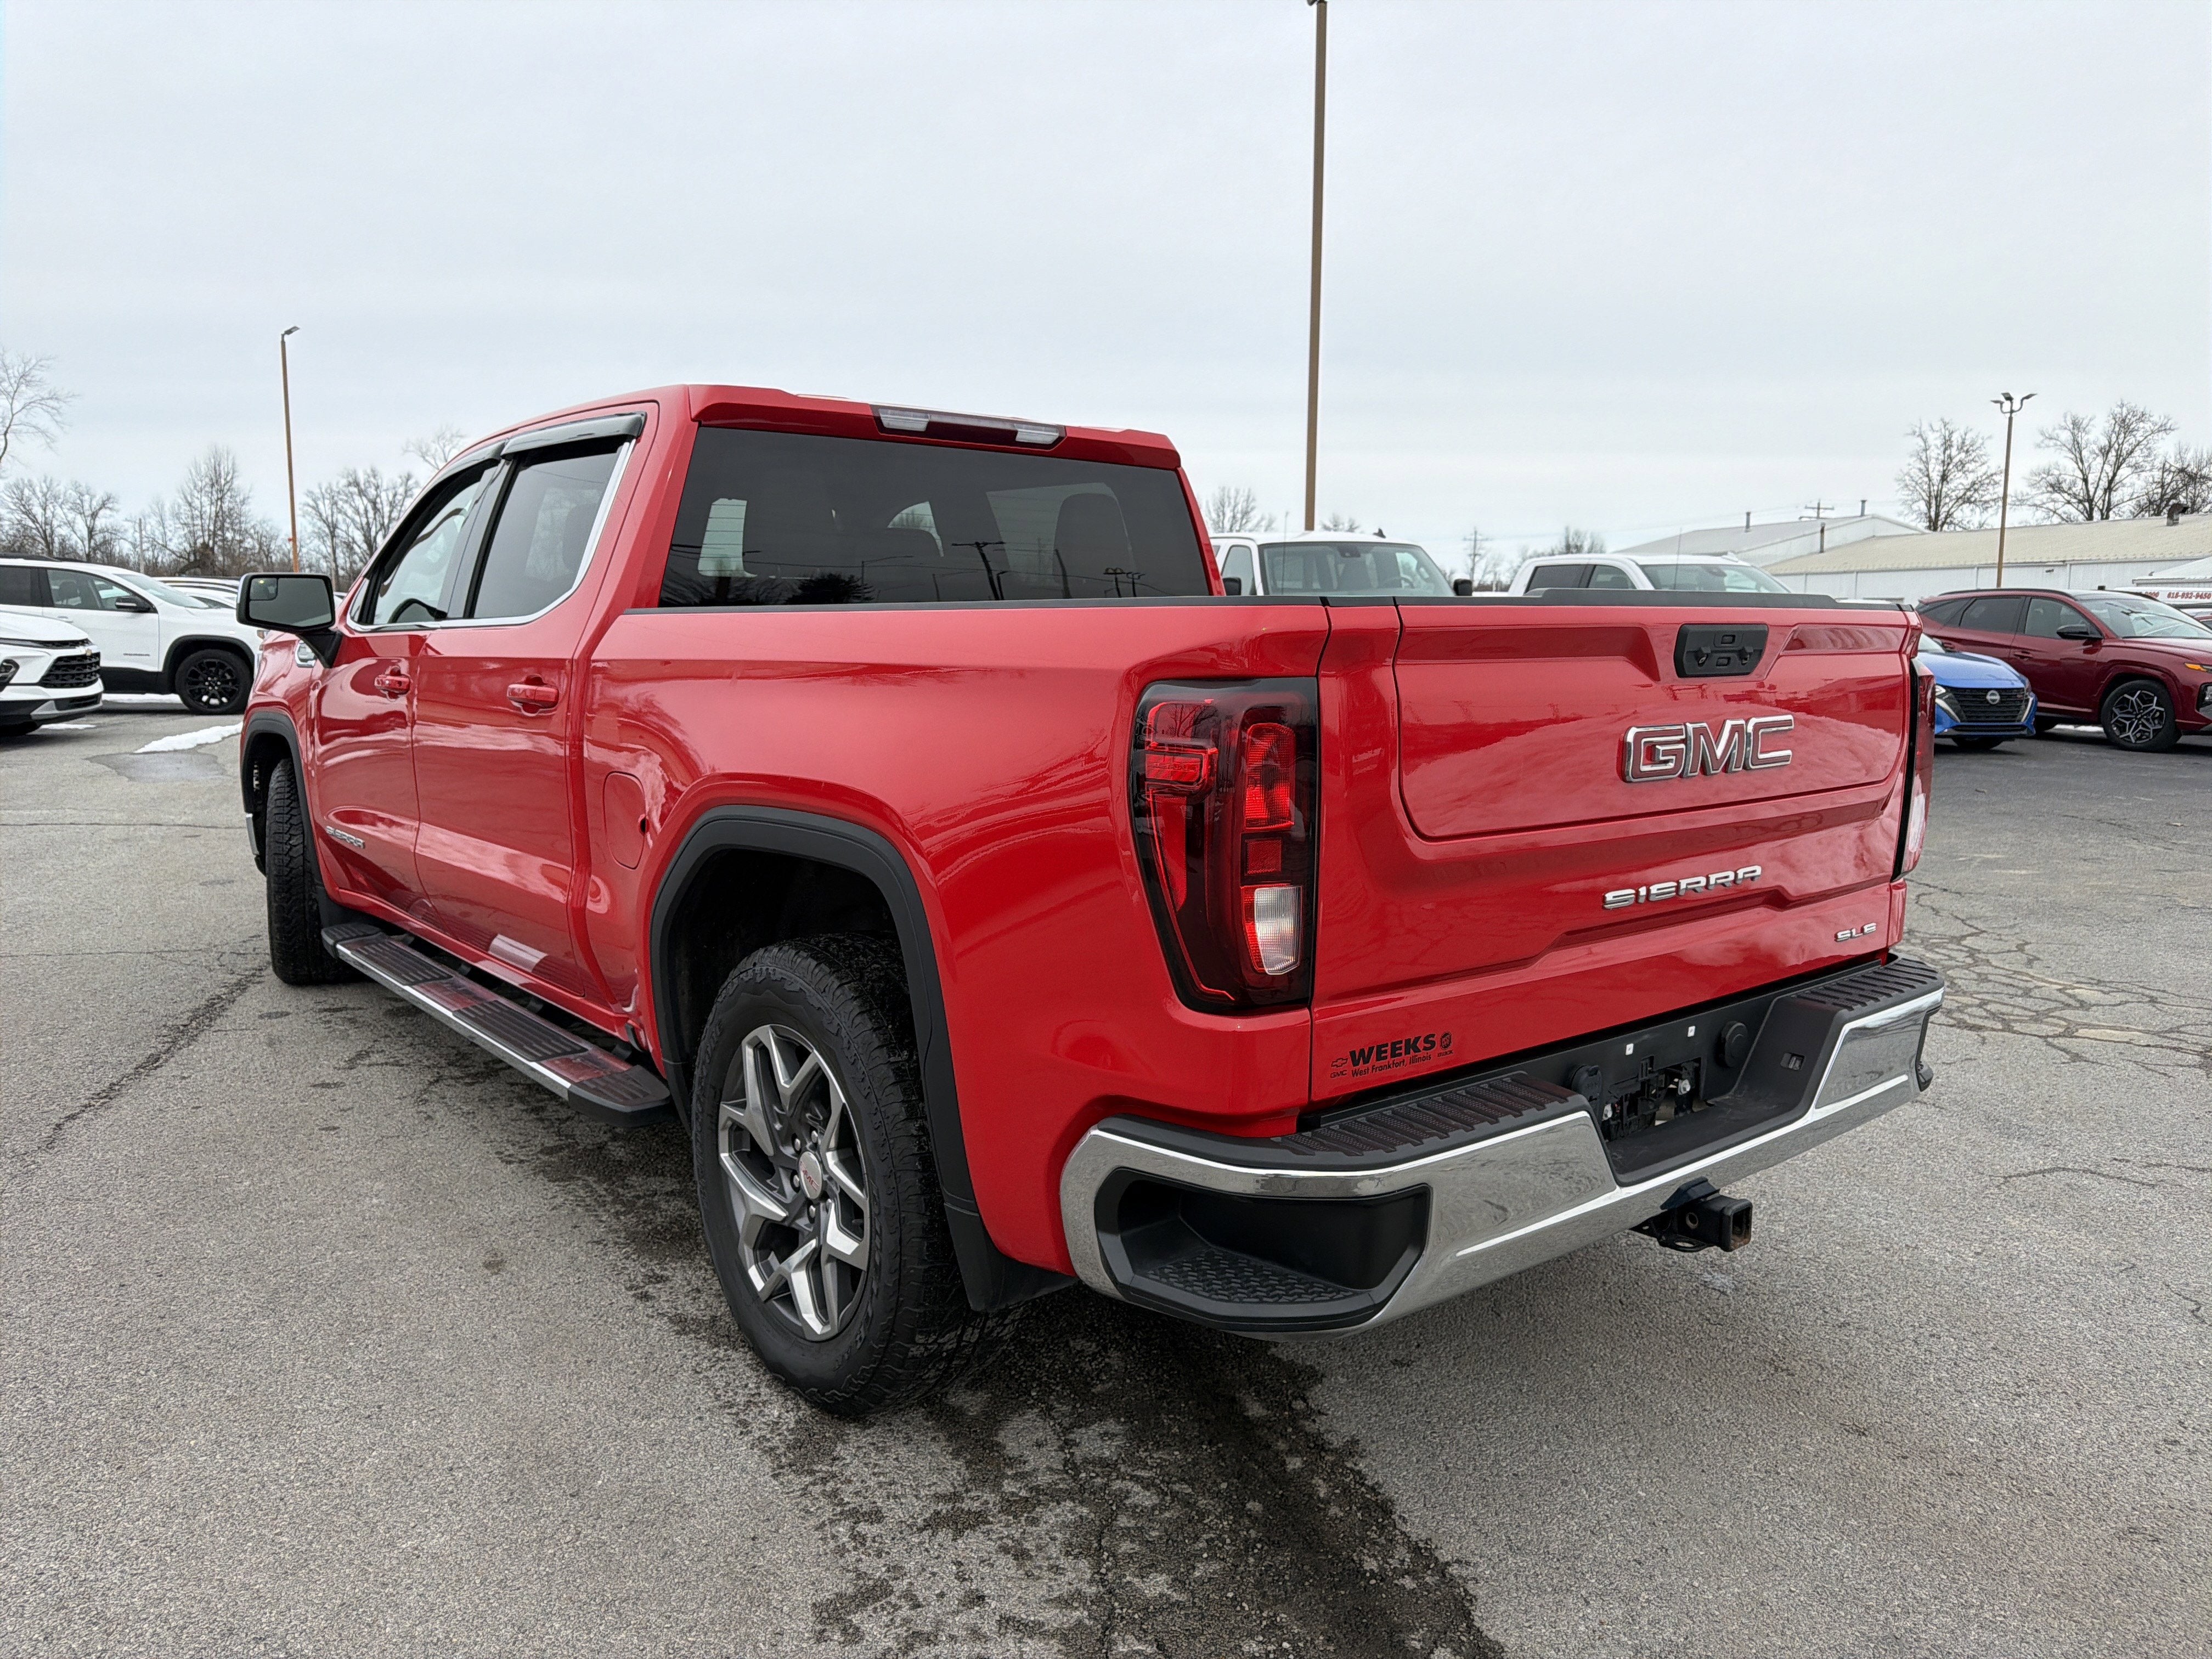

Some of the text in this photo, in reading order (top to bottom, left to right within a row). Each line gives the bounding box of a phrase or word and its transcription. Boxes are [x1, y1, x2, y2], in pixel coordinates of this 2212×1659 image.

[1622, 714, 1795, 783] GMC
[1602, 865, 1762, 910] SIERRA
[1835, 922, 1877, 942] SLE
[1349, 1033, 1436, 1068] WEEKS
[1351, 1052, 1432, 1077] West Frankfort, Illinois
[1330, 1069, 1348, 1079] GMC
